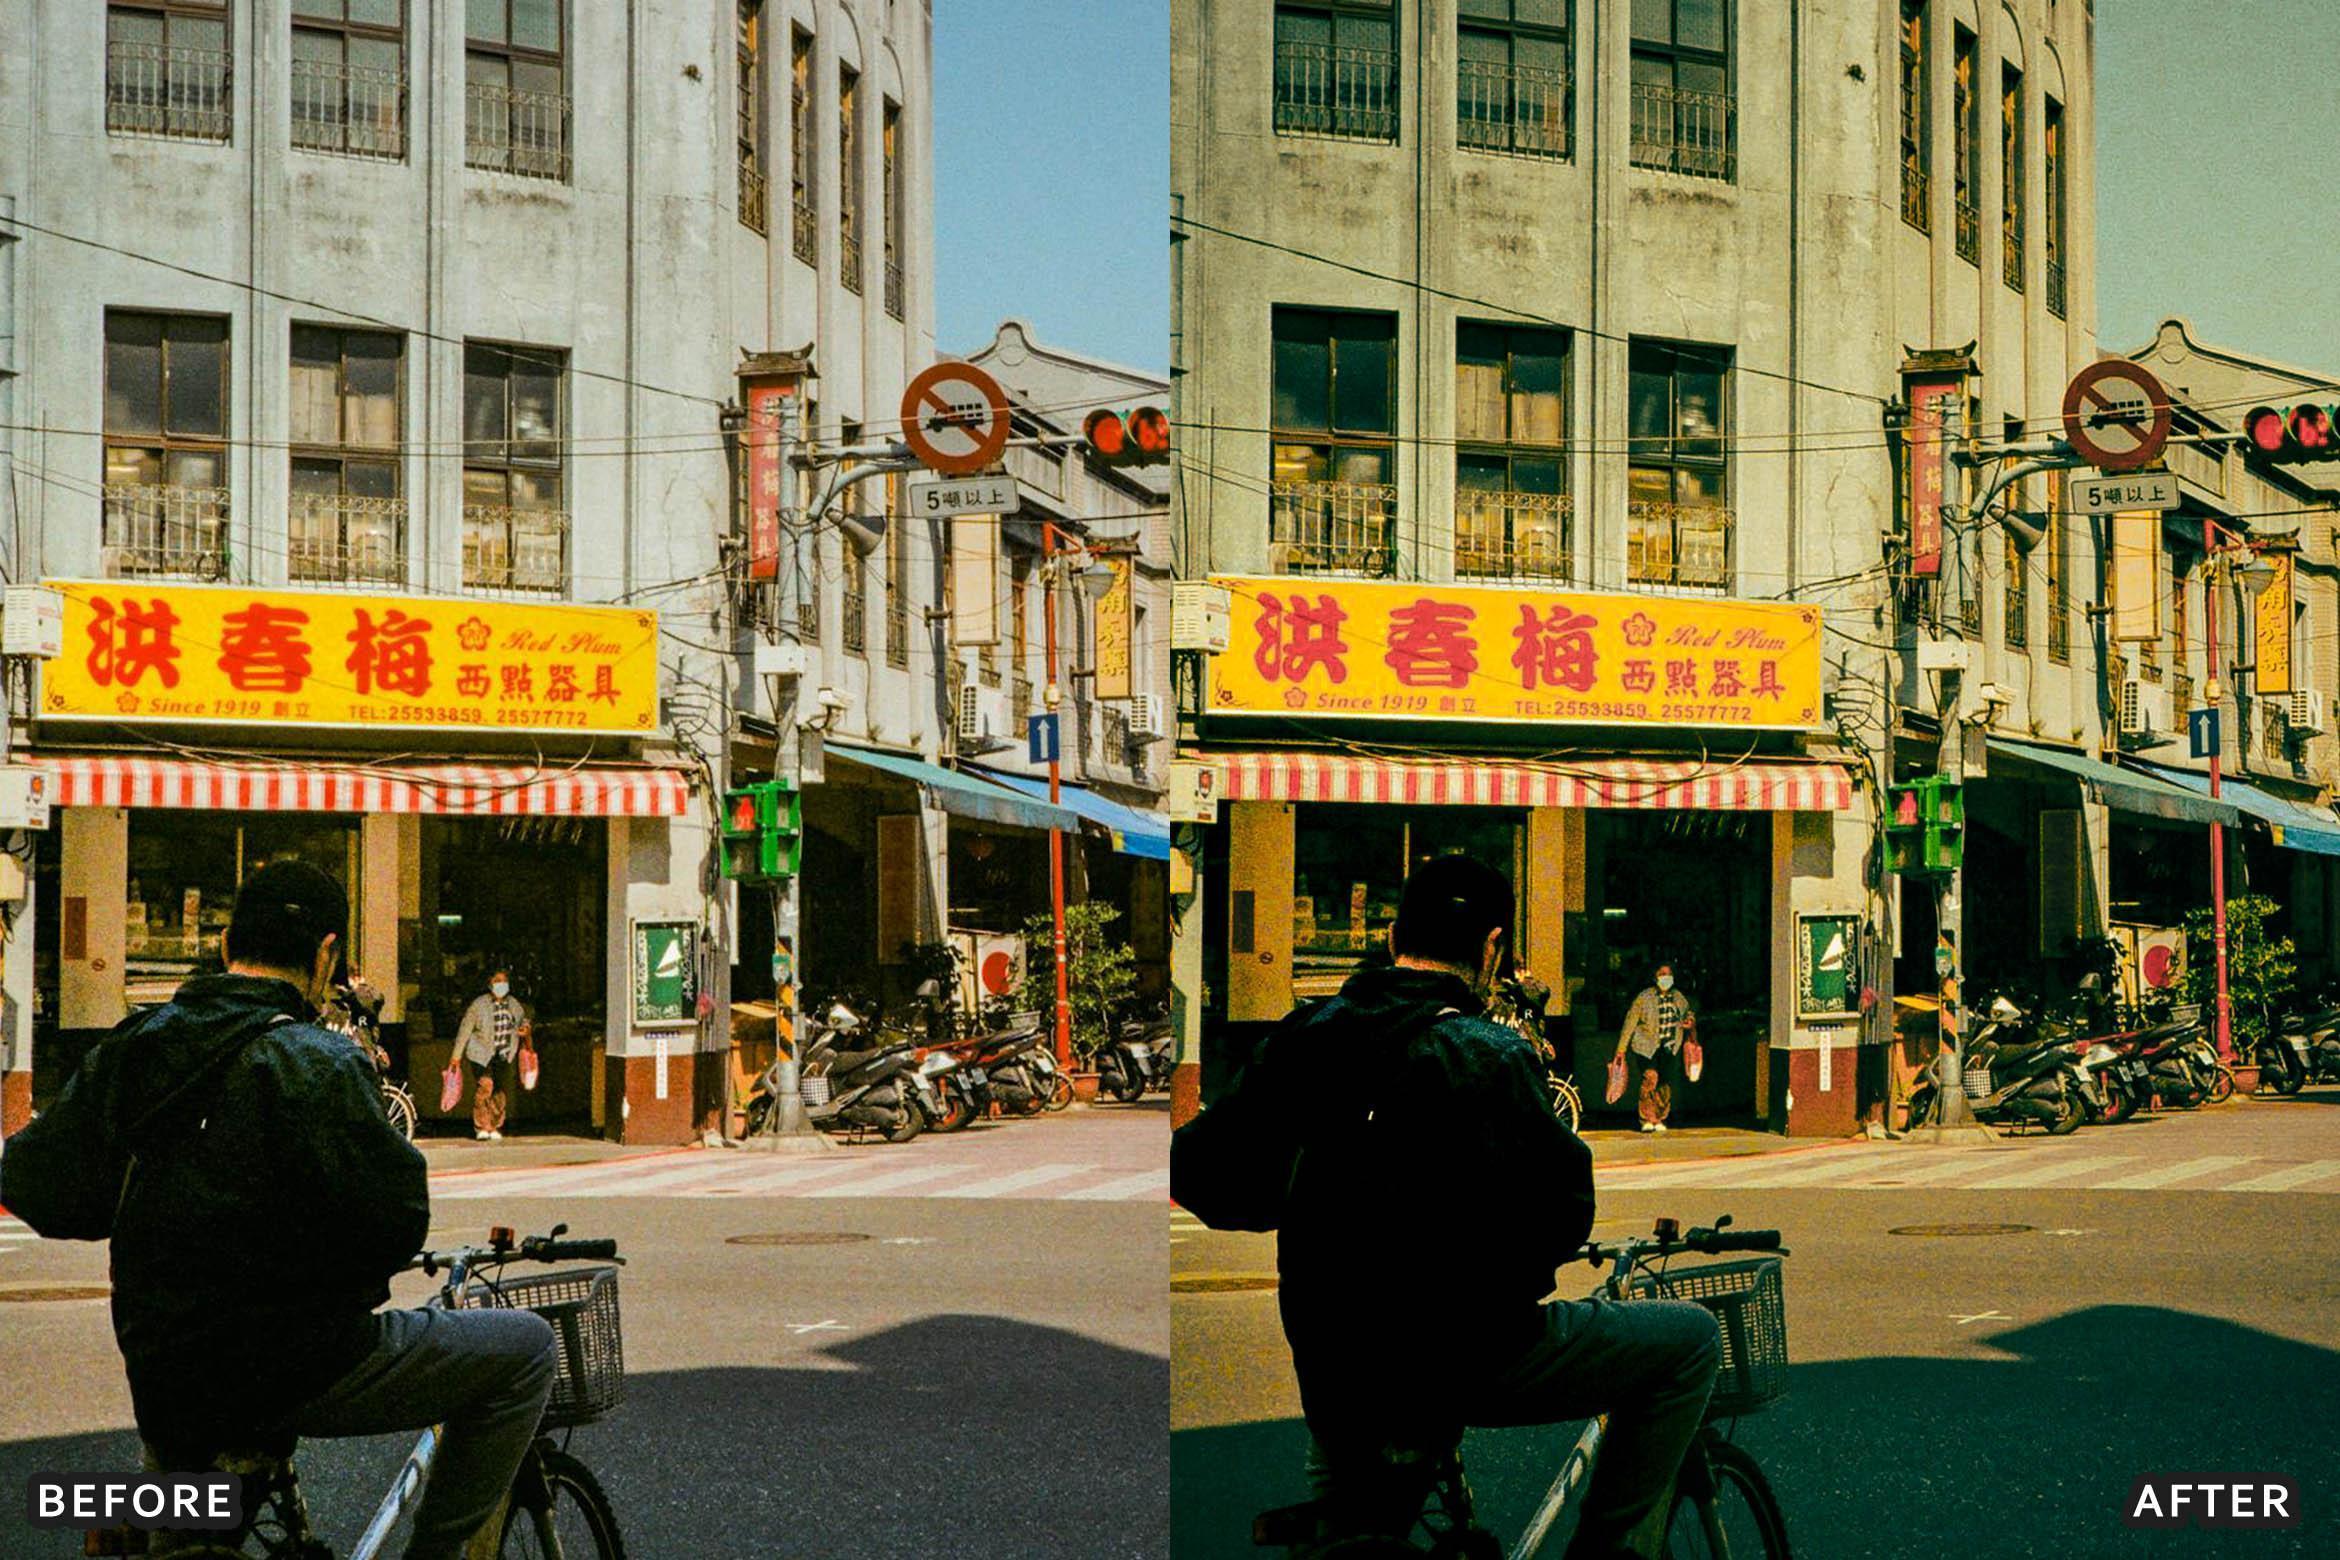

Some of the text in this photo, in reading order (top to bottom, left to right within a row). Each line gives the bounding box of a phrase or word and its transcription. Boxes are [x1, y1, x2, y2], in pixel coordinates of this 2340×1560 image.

[86, 596, 435, 697] 洪春梅
[501, 629, 622, 655] Red Plum
[1252, 592, 1599, 692] 洪春梅
[1664, 625, 1786, 651] Red Plum
[456, 662, 623, 707] 西點器具
[1621, 657, 1786, 702] 西點器具
[150, 697, 206, 715] Since
[214, 699, 262, 716] 1919
[1317, 692, 1373, 710] Since
[1380, 694, 1428, 711] 1919
[1661, 703, 1752, 721] 25577772
[497, 708, 588, 726] 25577772
